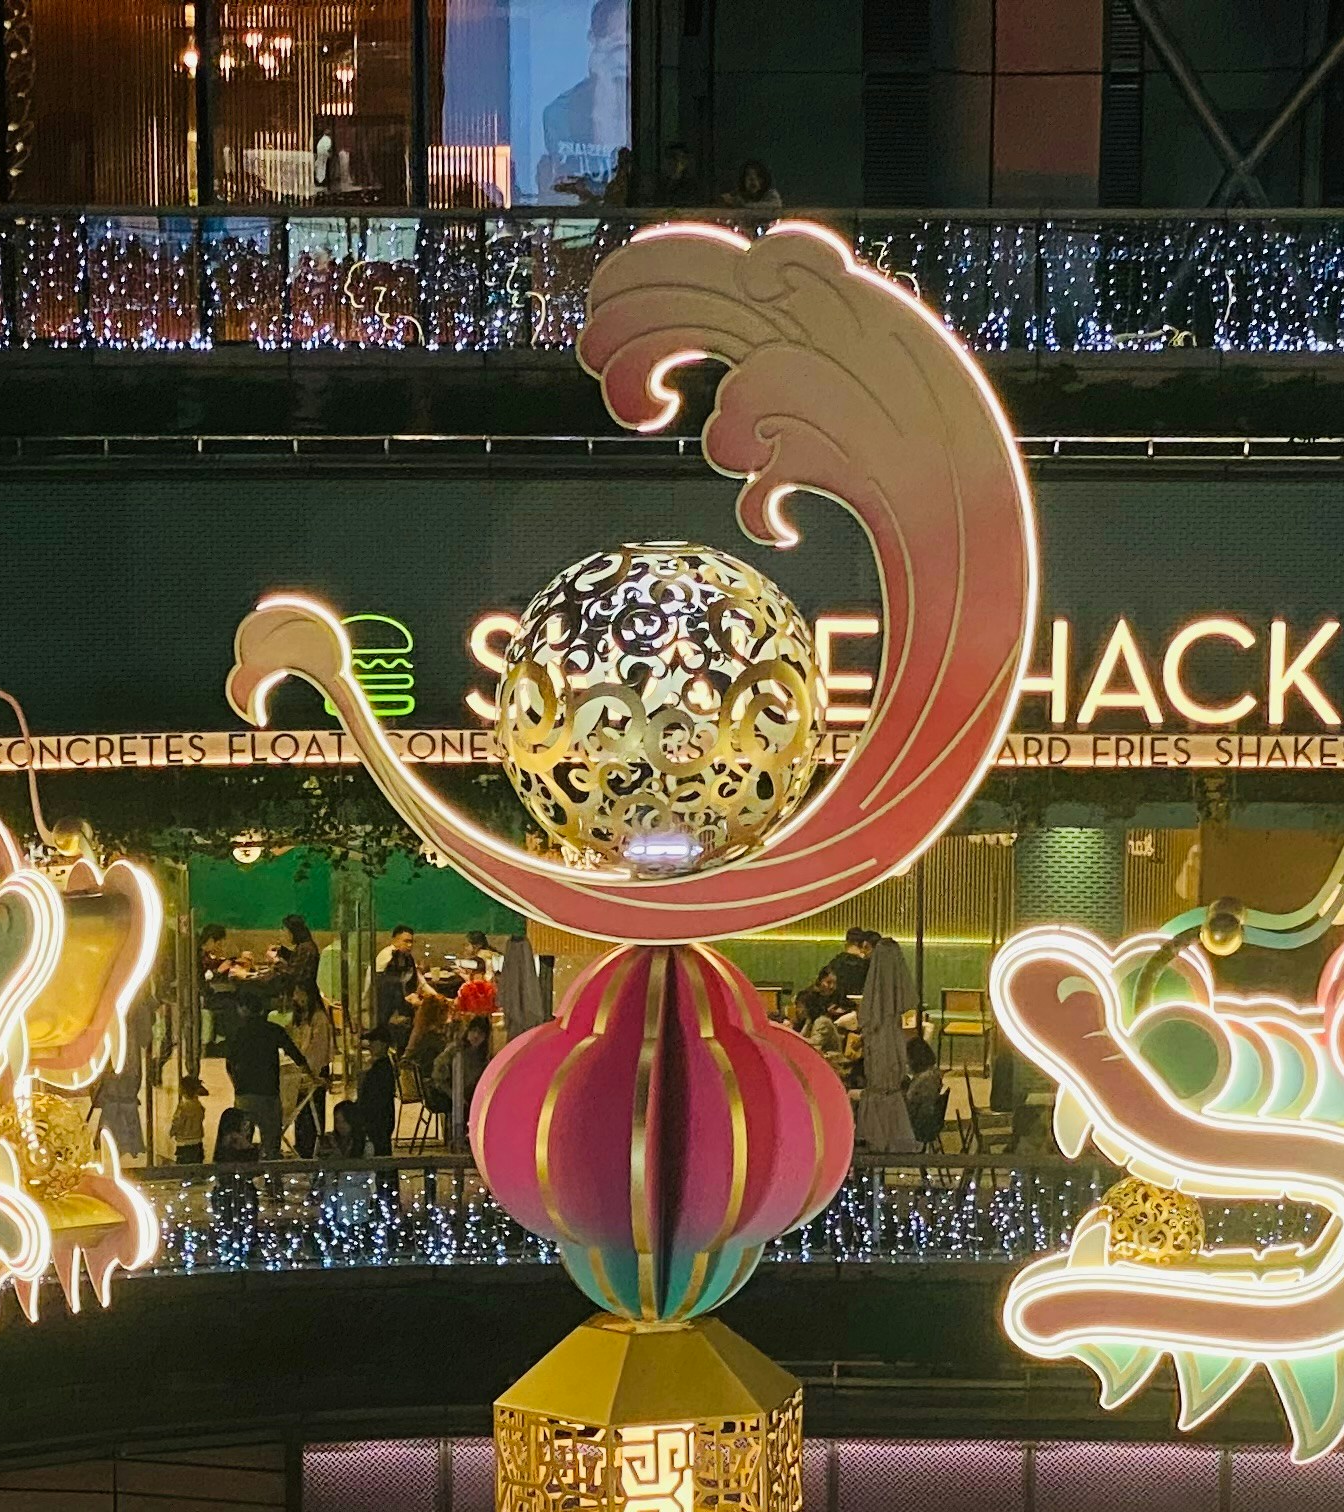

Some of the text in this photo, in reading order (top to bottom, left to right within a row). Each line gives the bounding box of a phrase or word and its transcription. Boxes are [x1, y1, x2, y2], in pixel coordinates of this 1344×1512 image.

[1018, 617, 1343, 726] HACK
[227, 732, 348, 763] FLOAT
[1091, 736, 1192, 766] FRIES
